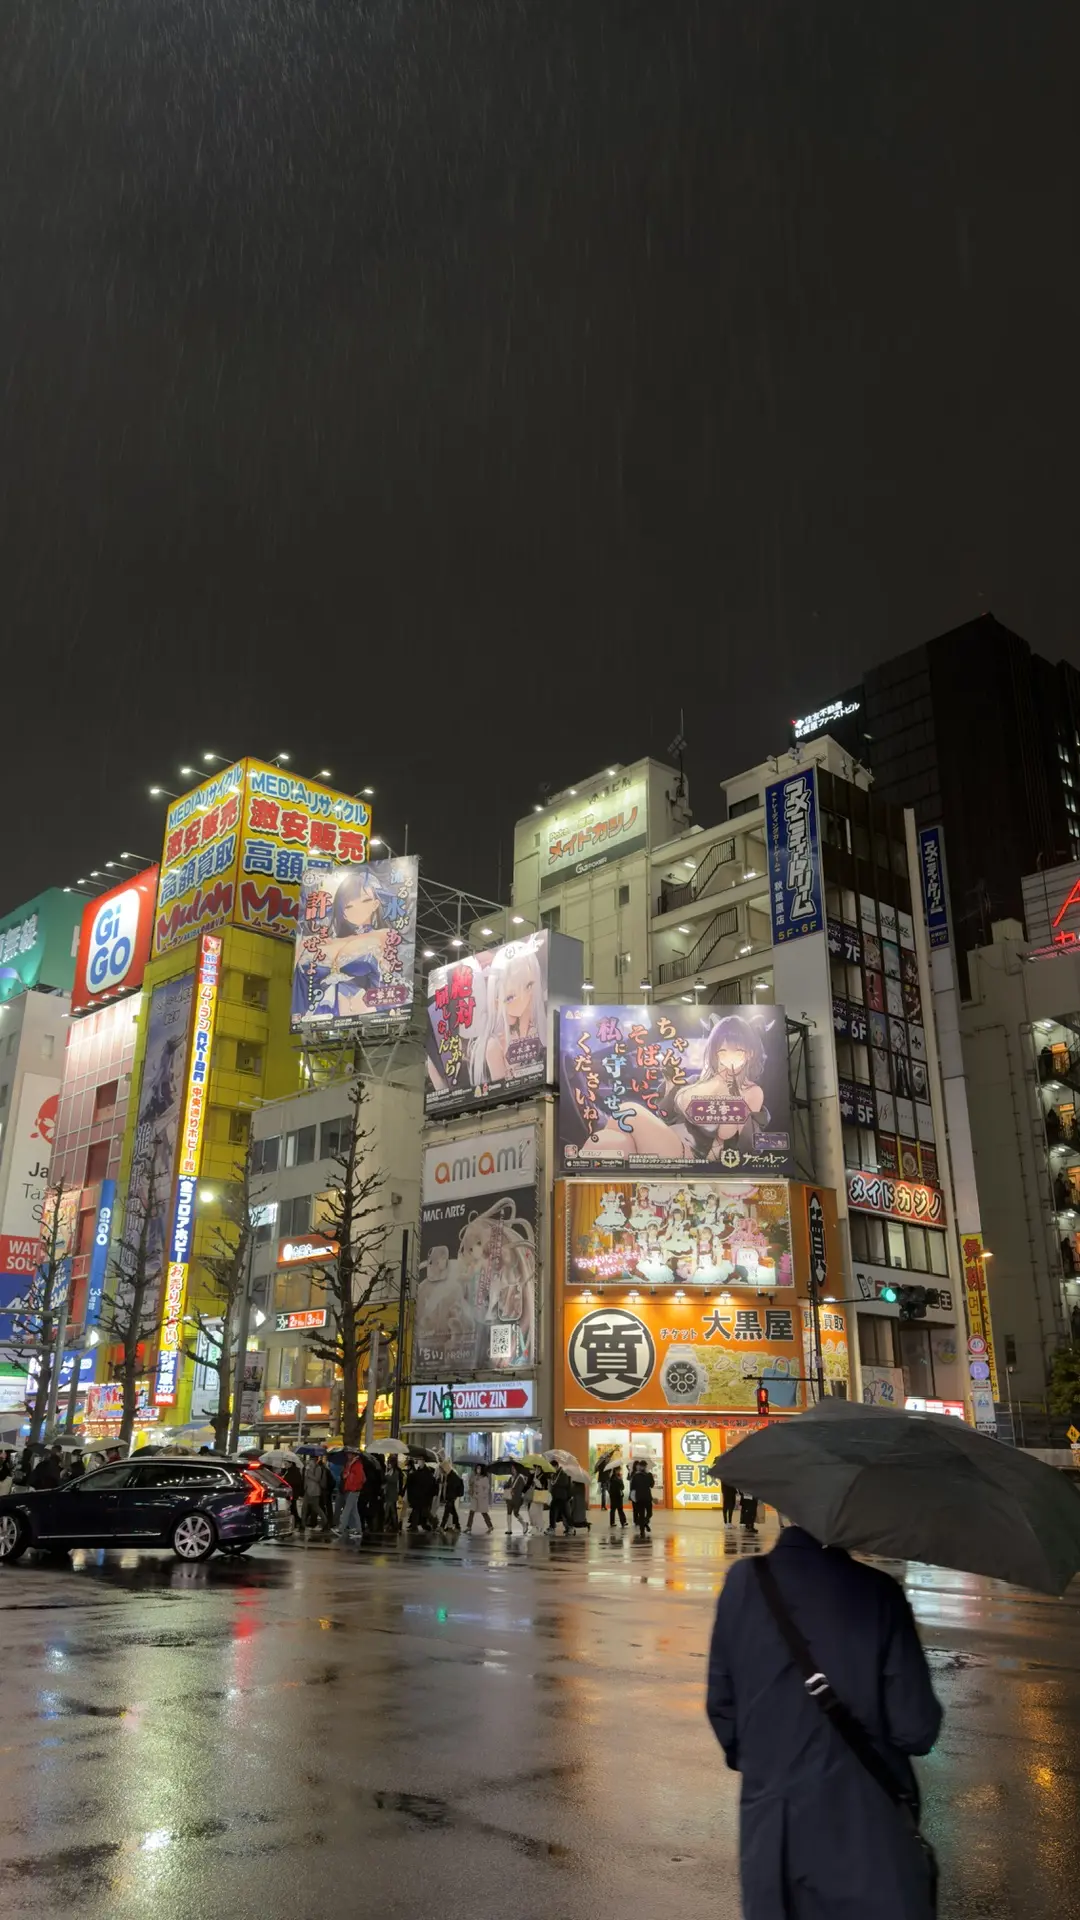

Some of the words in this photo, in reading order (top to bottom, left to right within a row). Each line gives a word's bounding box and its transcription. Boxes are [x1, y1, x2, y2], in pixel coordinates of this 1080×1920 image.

[168, 764, 244, 829] MEDIAリサイクル
[250, 770, 368, 825] MEDIAリサイクル
[165, 795, 240, 866] 激安販売
[249, 798, 364, 861] 激安販売
[160, 834, 236, 906] 高額買取
[156, 882, 233, 950] Mulan
[773, 881, 785, 925] 秋葉原店
[90, 936, 131, 985] GO
[845, 943, 861, 962] 7F
[656, 1017, 688, 1086] ちゃんと
[851, 1020, 867, 1040] 6F
[597, 1016, 637, 1133] 私に守らせて
[857, 1104, 874, 1124] 5F
[434, 1144, 526, 1184] amiami
[742, 1152, 789, 1167] アズールレーン
[850, 1174, 941, 1220] メイドカジノ
[96, 1207, 111, 1246] GiGO
[659, 1328, 698, 1340] チケット
[702, 1309, 795, 1341] 大黒屋
[580, 1321, 646, 1389] 質
[489, 1390, 507, 1408] ZIN
[684, 1435, 707, 1457] 質
[675, 1464, 720, 1487] 買取
